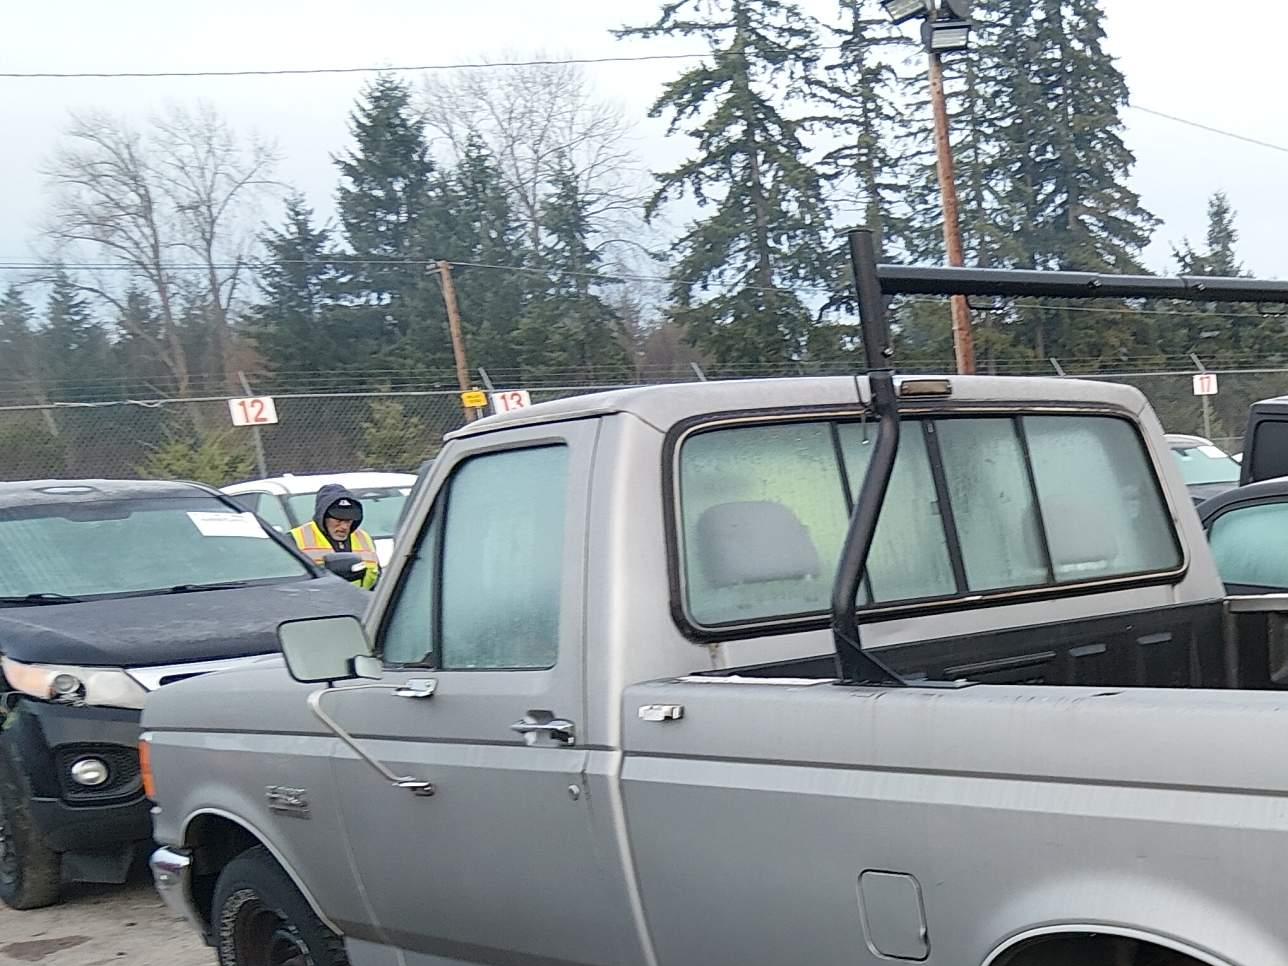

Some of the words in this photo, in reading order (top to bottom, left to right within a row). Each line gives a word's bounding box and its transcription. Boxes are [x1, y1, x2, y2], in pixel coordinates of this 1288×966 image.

[1198, 375, 1212, 393] 17
[238, 398, 268, 424] 12
[500, 391, 524, 412] 13
